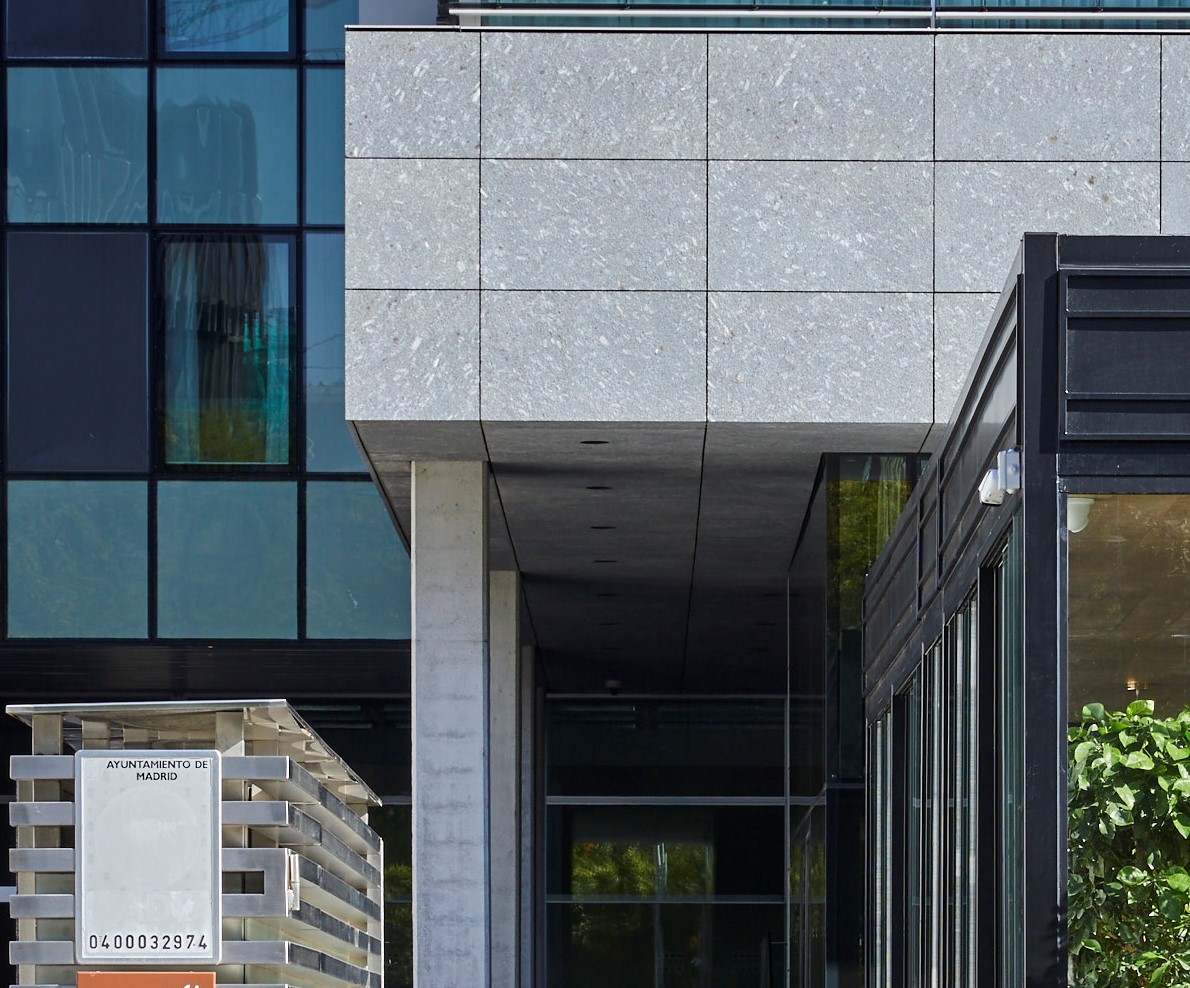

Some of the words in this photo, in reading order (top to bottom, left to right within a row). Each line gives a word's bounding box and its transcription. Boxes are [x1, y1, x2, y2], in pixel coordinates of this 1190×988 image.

[106, 760, 191, 769] AYUNTAMIENTO
[195, 760, 208, 769] DE
[136, 772, 178, 781] MADRID
[89, 934, 208, 949] 0400032974
